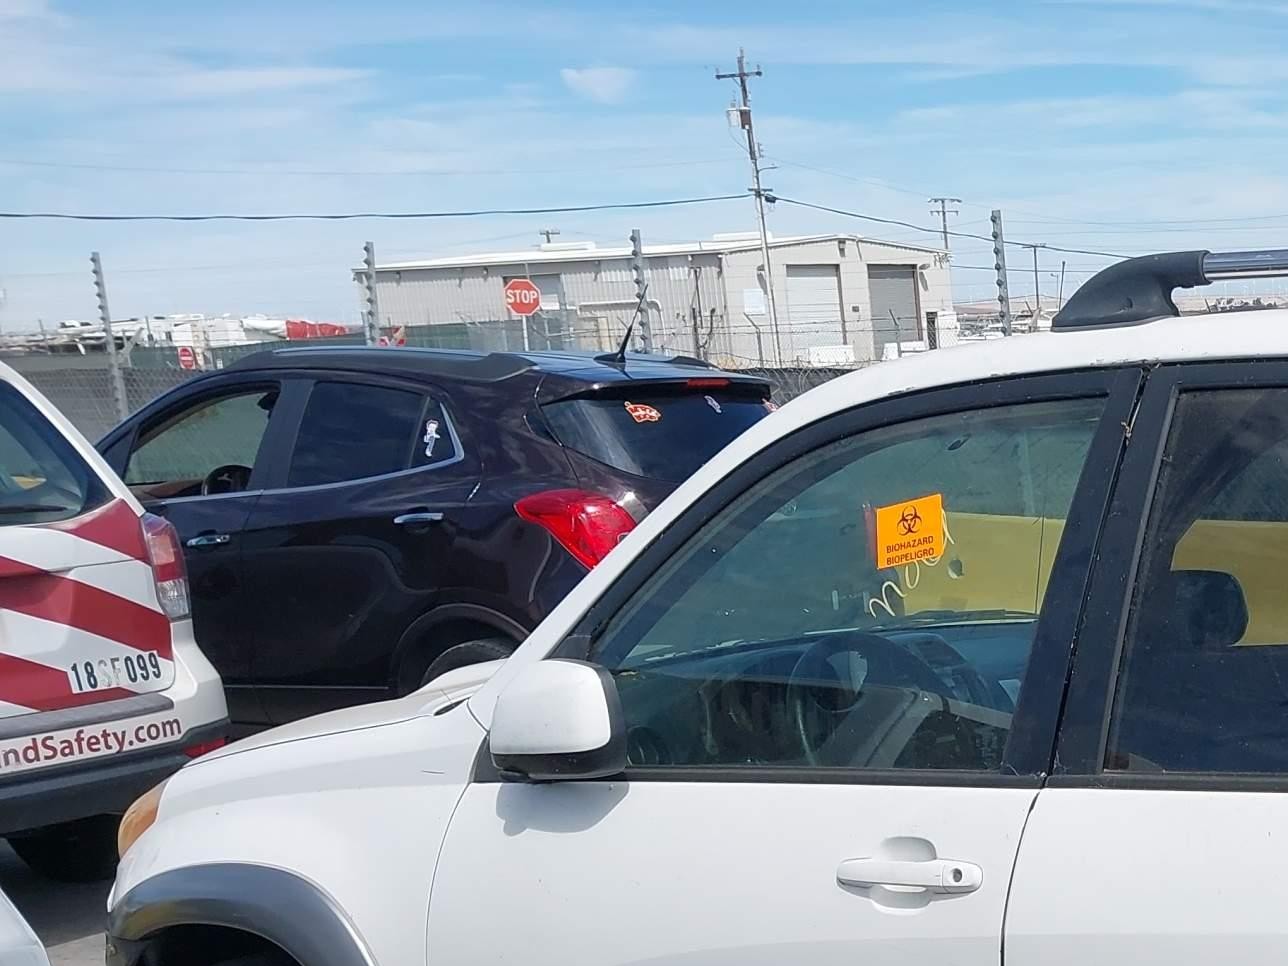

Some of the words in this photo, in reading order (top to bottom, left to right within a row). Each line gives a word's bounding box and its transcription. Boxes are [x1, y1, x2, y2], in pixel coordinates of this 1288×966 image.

[506, 289, 537, 304] STOP
[886, 535, 934, 554] BIOHAZARD
[886, 547, 935, 566] BIOPELIGRO
[71, 652, 162, 691] 18SF099
[0, 717, 182, 769] ndSafety.com
